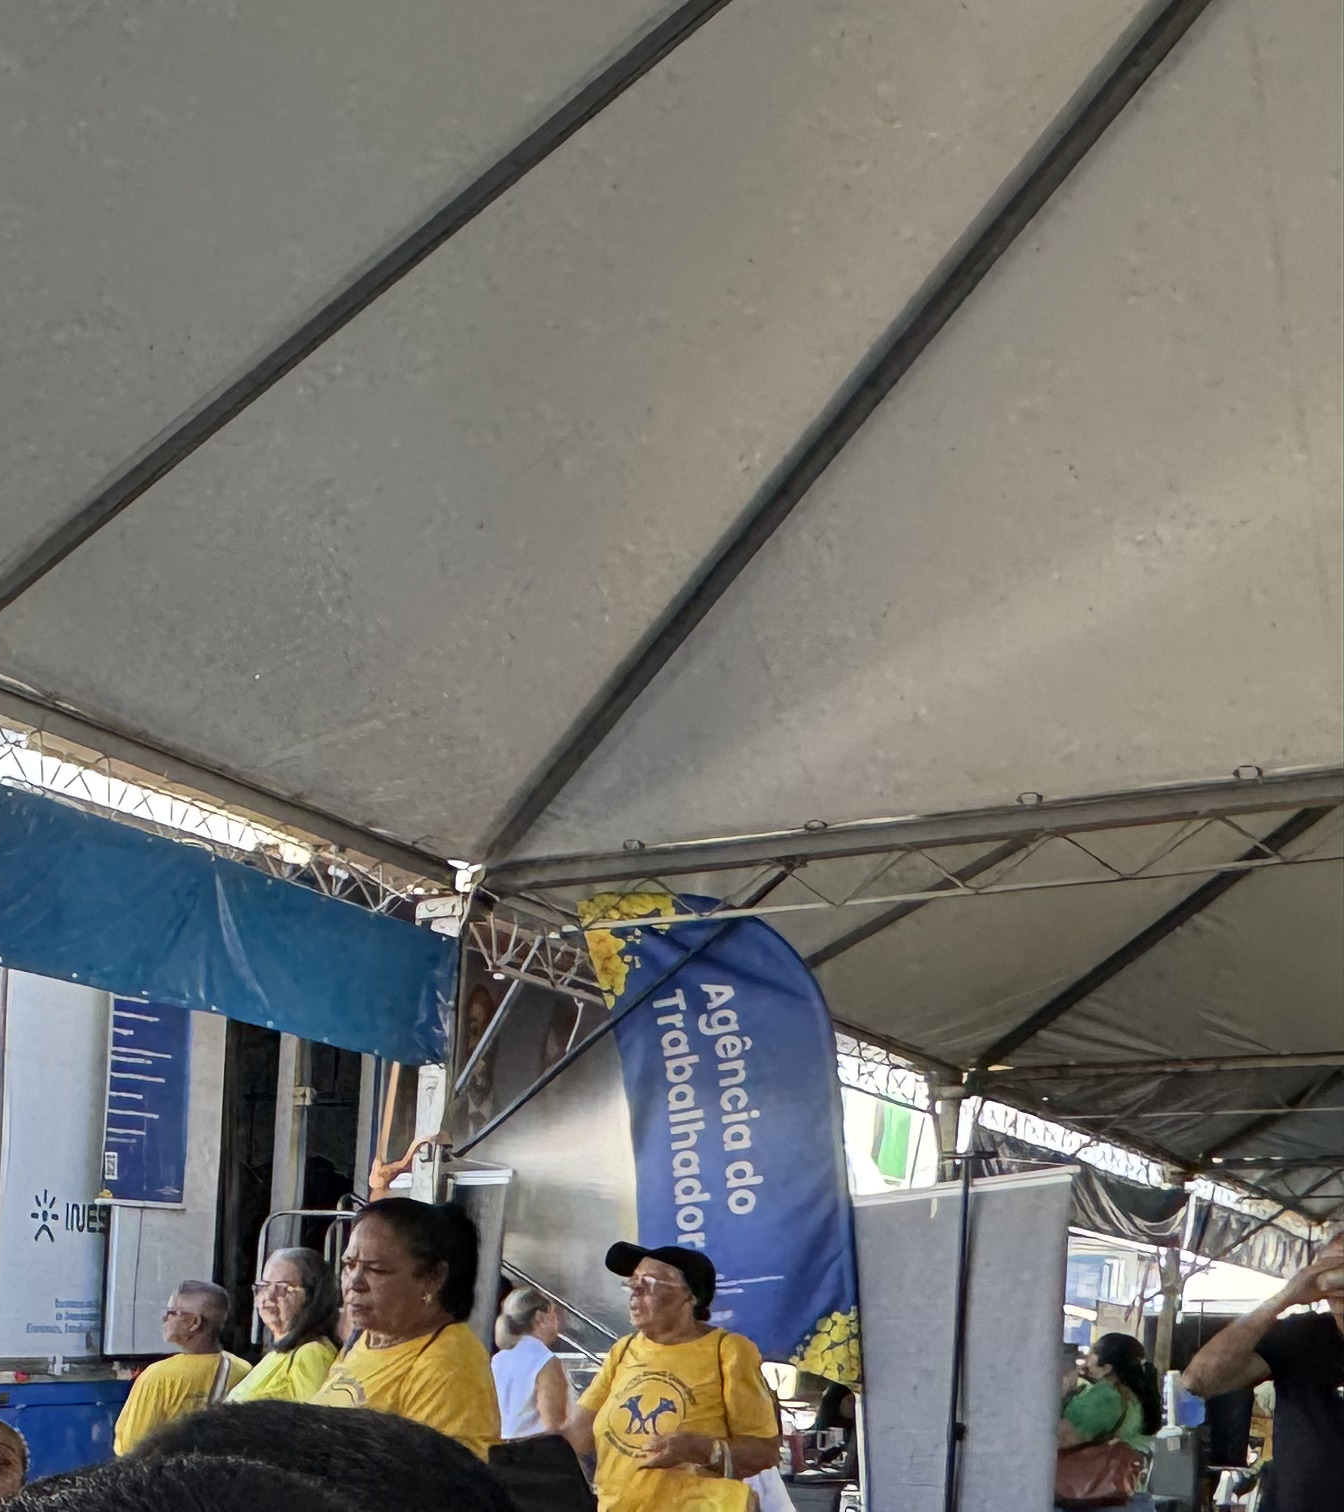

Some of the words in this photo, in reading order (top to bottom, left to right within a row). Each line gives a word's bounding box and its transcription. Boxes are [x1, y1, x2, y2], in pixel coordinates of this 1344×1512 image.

[652, 988, 711, 1249] Trabalhador
[698, 984, 761, 1151] Agência
[726, 1160, 764, 1215] do
